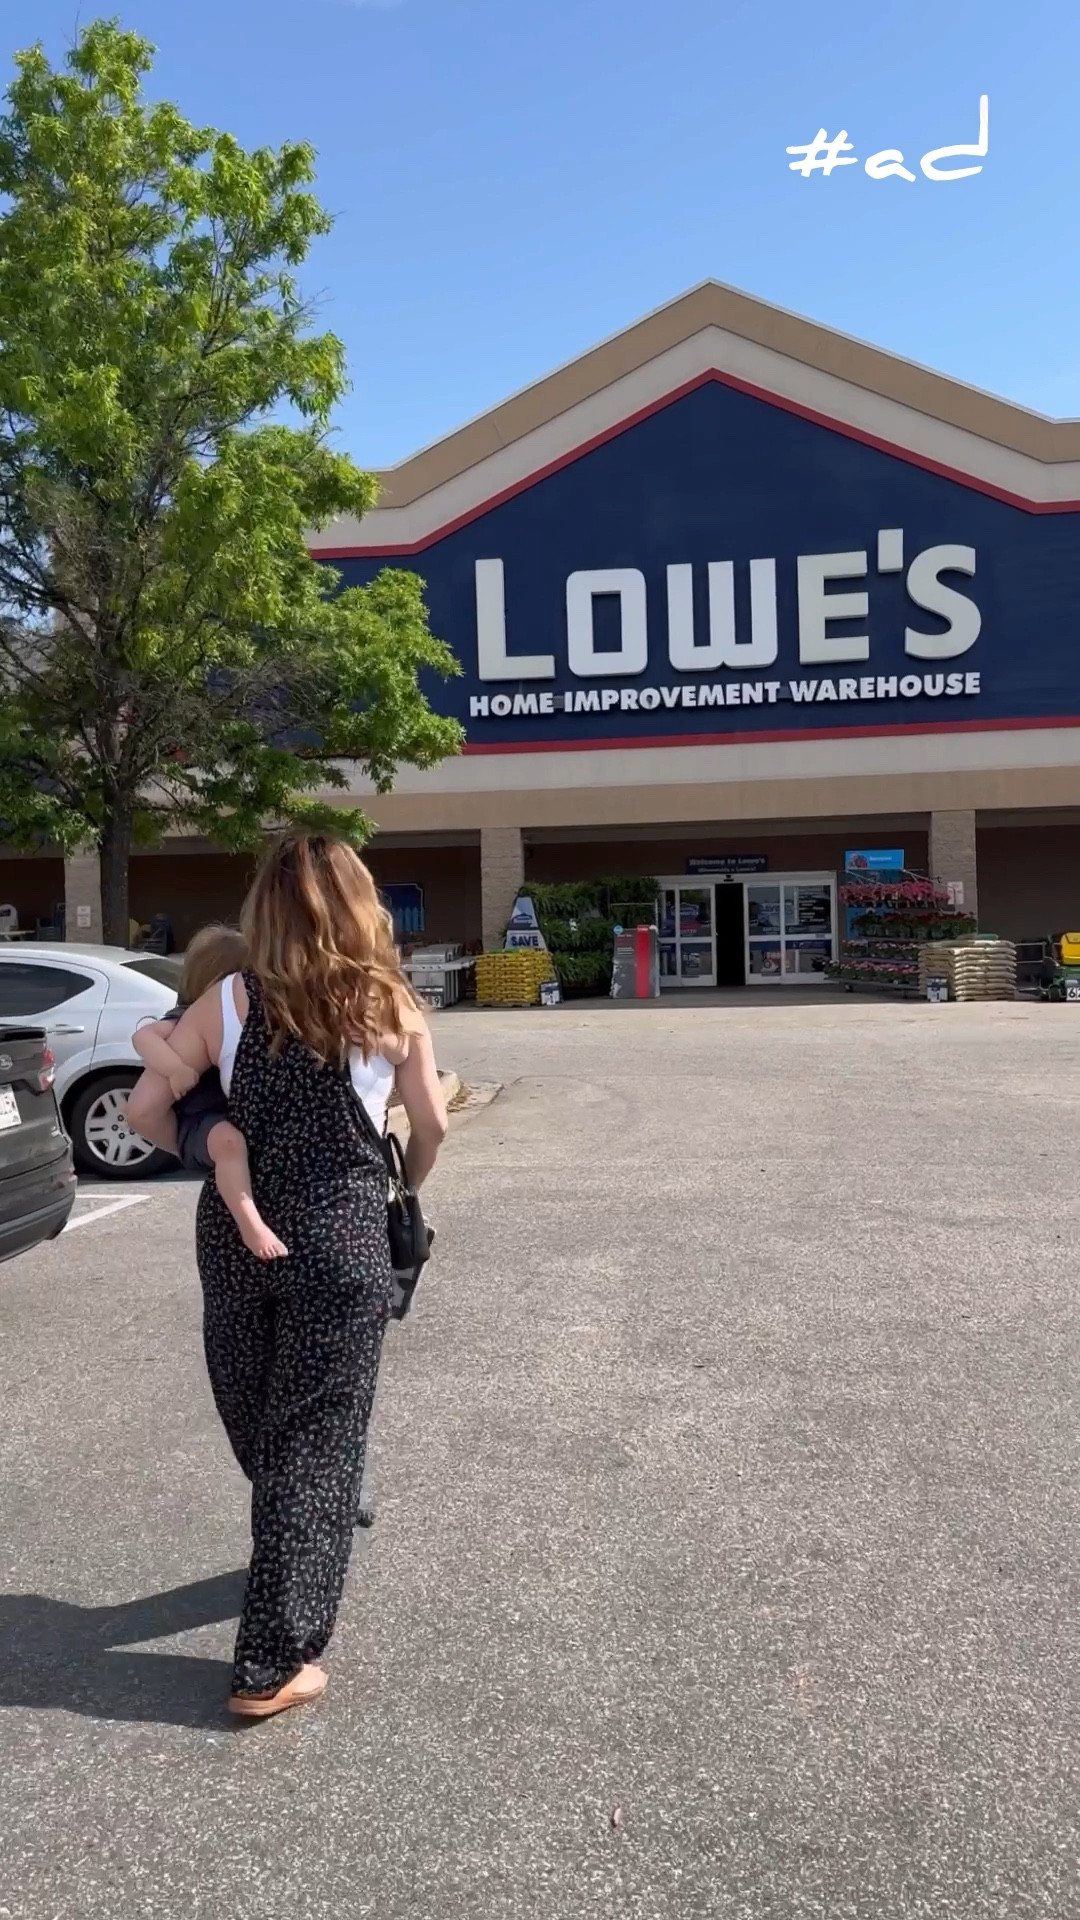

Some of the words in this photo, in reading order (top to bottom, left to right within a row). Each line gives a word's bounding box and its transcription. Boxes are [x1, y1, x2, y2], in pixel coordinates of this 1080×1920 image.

[474, 528, 982, 682] LOWE'S
[470, 692, 555, 717] HOME
[564, 681, 781, 713] IMPROVEMENT
[788, 672, 981, 704] WAREHOUSE
[511, 935, 539, 946] SAVE
